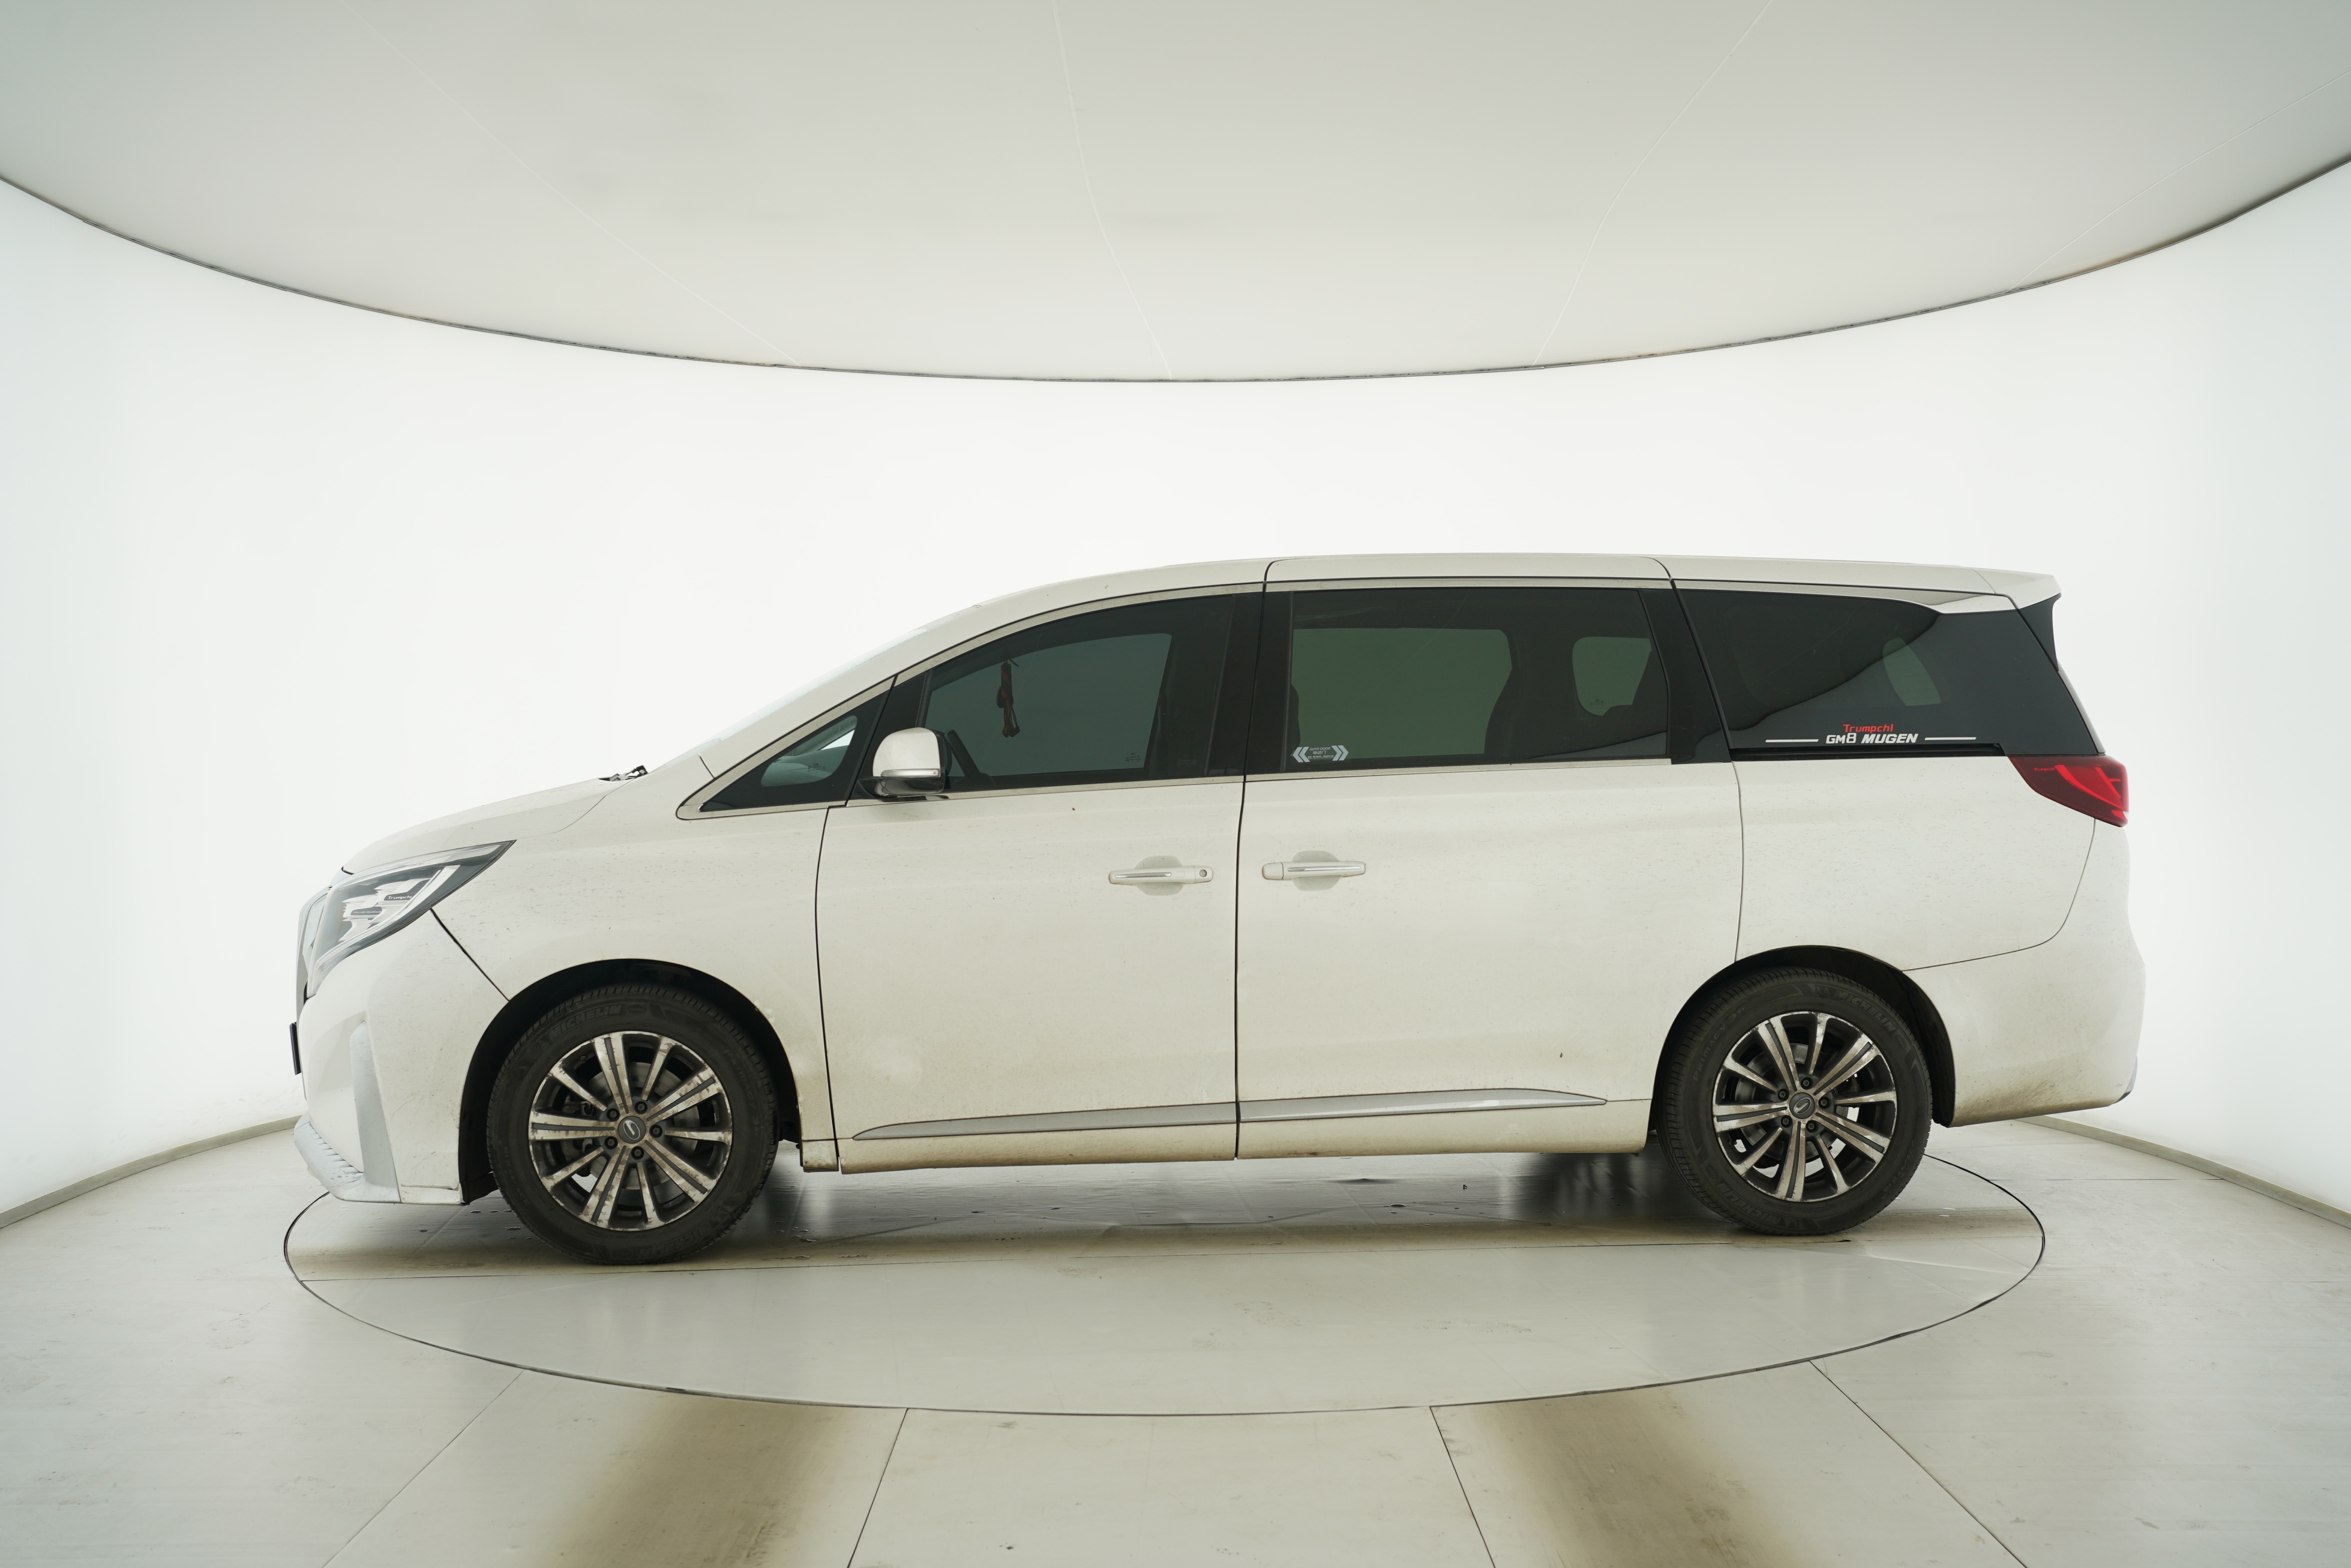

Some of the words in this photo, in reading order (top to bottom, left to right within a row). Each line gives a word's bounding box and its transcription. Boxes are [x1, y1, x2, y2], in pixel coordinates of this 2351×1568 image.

[1826, 733, 1857, 743] GM8
[1861, 733, 1918, 743] MUGEN
[548, 1003, 622, 1041] MICHELIN
[1834, 990, 1897, 1032] MICHELIN
[1716, 1182, 1782, 1225] MICHELIN
